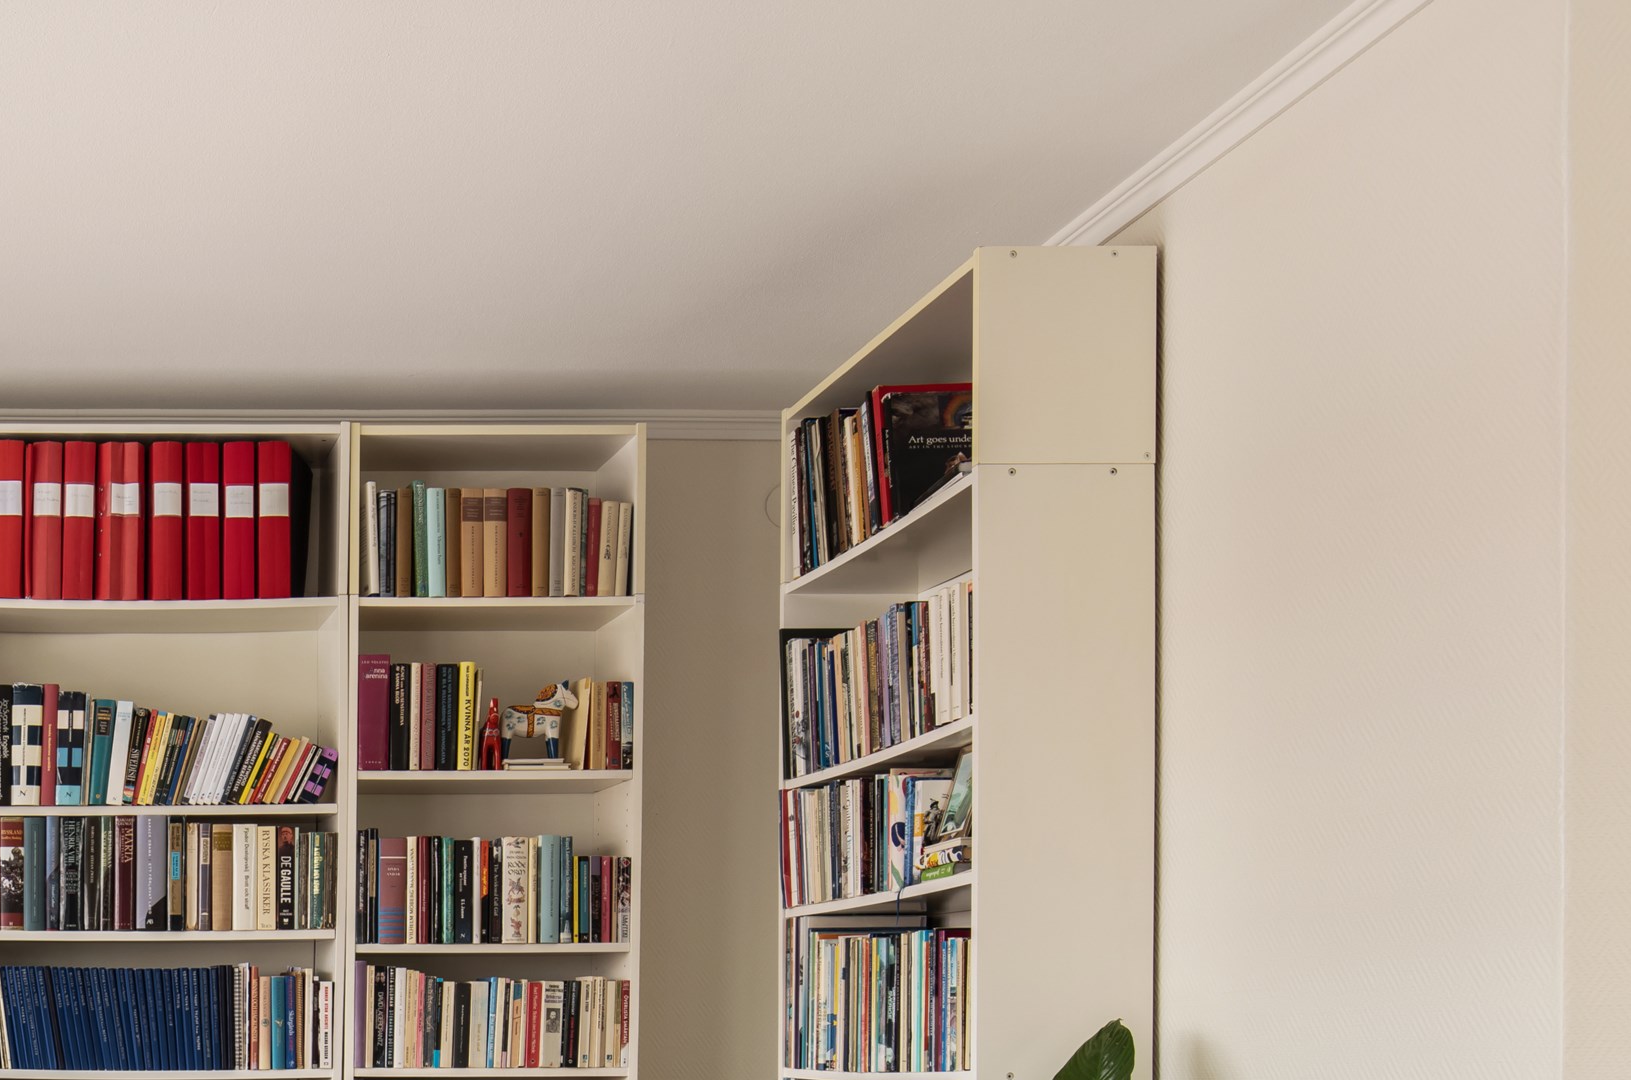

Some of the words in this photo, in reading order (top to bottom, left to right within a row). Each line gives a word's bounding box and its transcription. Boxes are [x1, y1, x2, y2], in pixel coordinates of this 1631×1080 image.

[908, 435, 924, 444] Art
[926, 436, 947, 446] goes
[464, 734, 470, 744] ÅR
[127, 748, 141, 781] SWEDISH
[68, 820, 76, 849] HENRIK
[124, 828, 133, 862] MARIA
[262, 830, 271, 860] RYSKA
[68, 851, 76, 863] VIII
[281, 856, 292, 868] DE
[262, 863, 271, 914] KLASSIKER
[281, 870, 292, 903] GAULLE
